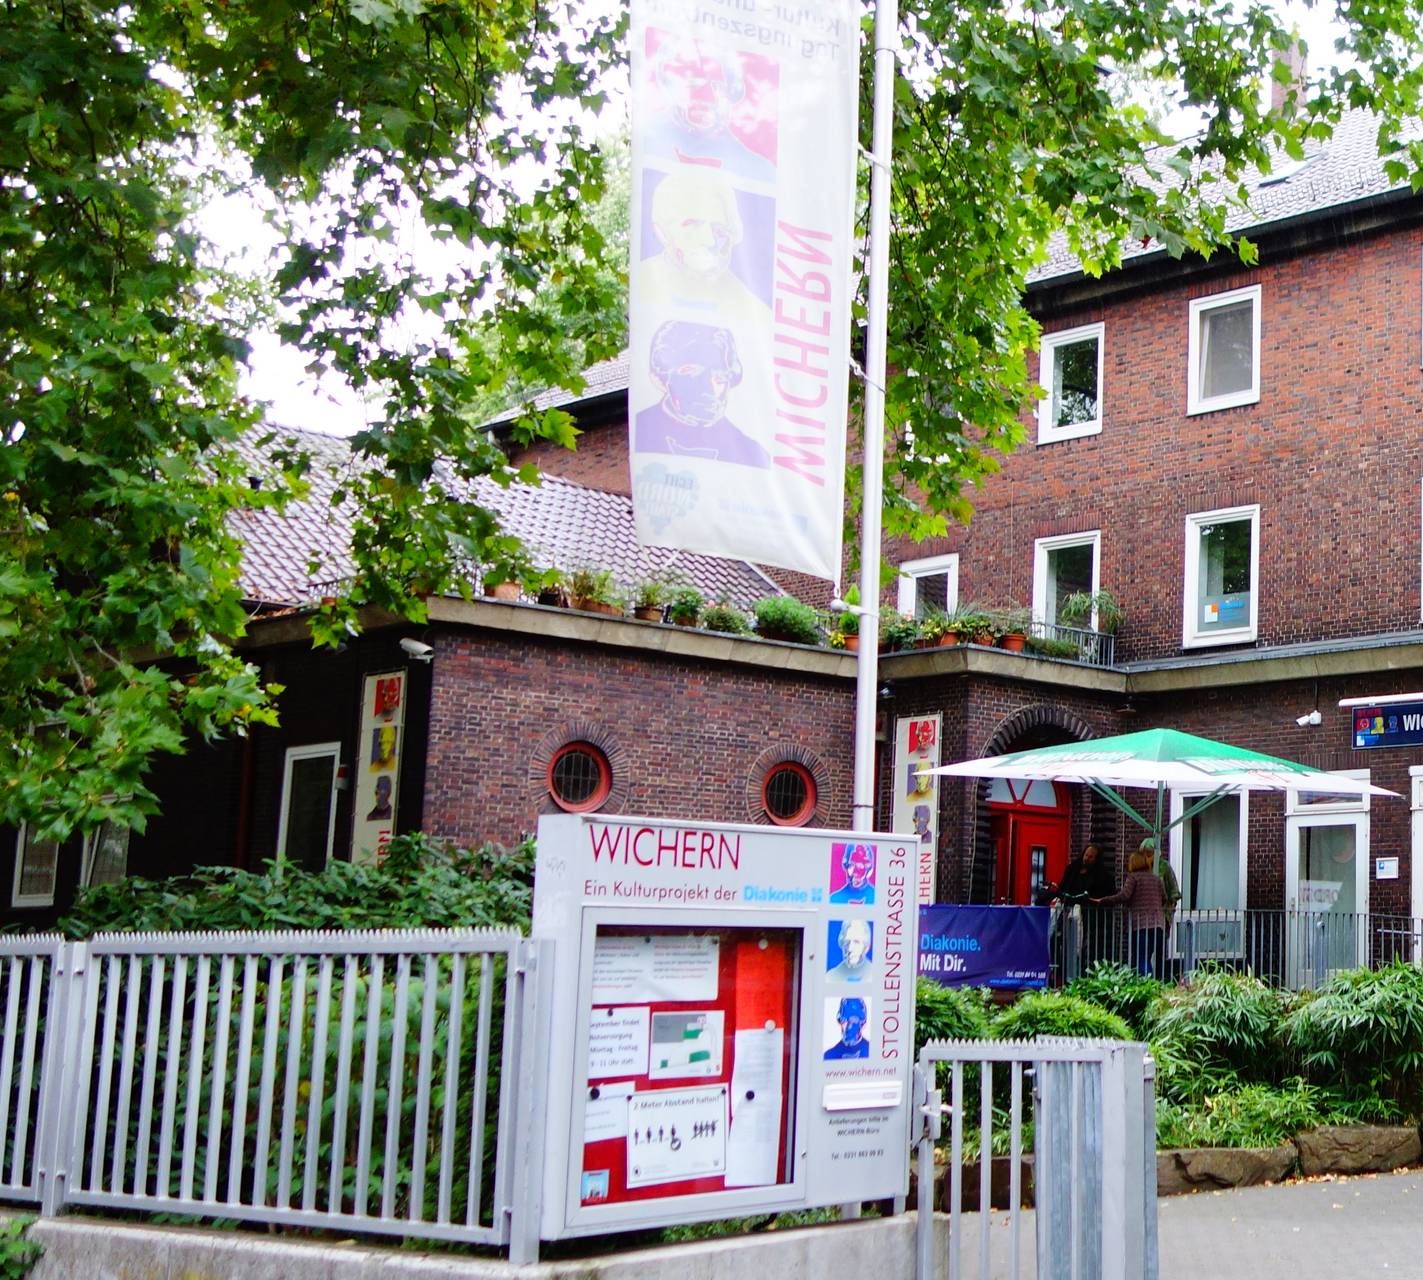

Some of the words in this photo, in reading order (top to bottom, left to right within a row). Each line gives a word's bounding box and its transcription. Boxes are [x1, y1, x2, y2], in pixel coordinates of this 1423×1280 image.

[589, 824, 741, 870] WICHERN
[889, 847, 906, 868] 36
[584, 879, 607, 897] Ein
[613, 880, 710, 903] Kulturprojekt
[714, 885, 738, 902] der
[743, 885, 808, 904] Diakonie
[920, 934, 981, 951] Diakonie.
[882, 876, 905, 1059] STOLLENSTRASSE
[920, 953, 941, 971] Mit
[943, 954, 967, 972] Dir.
[825, 1067, 897, 1079] www.wichern.net
[640, 1101, 663, 1110] Meter
[663, 1098, 695, 1109] Abstand
